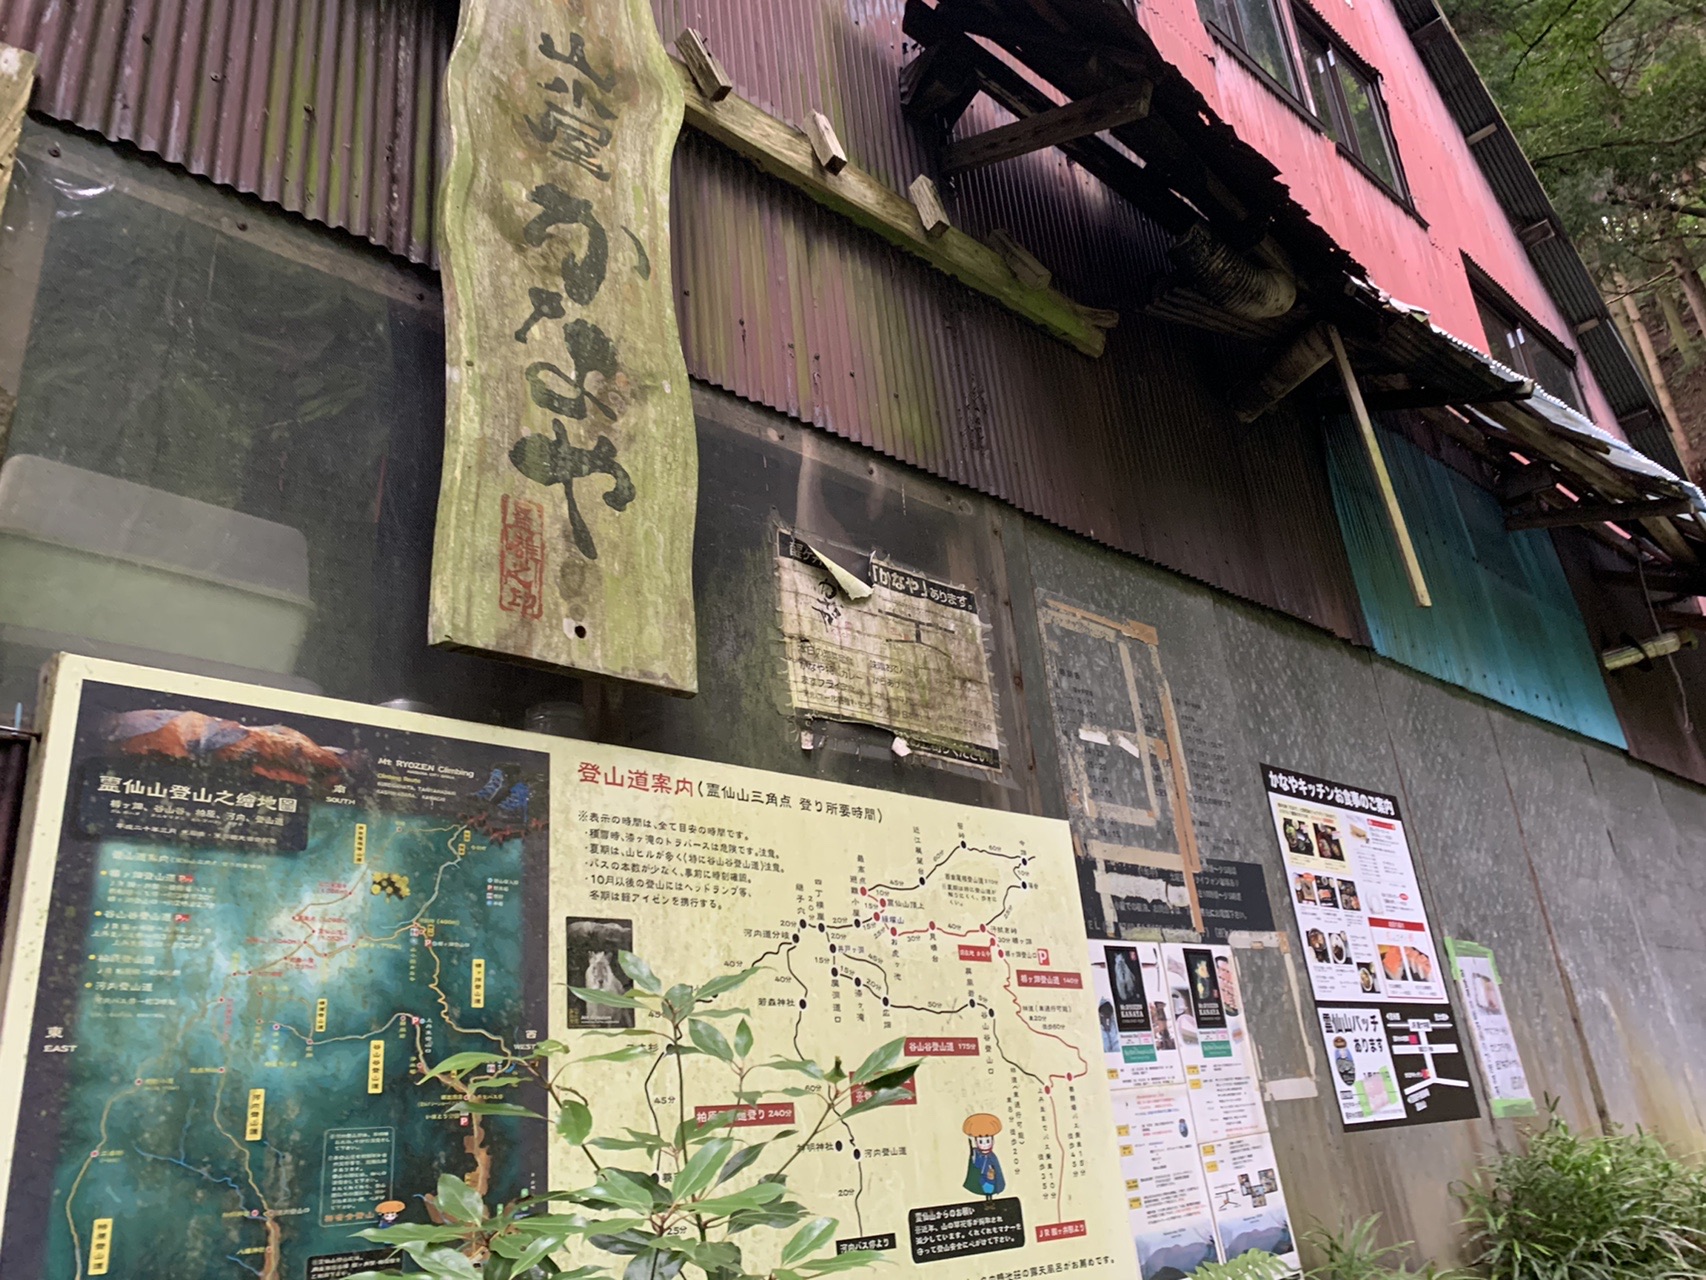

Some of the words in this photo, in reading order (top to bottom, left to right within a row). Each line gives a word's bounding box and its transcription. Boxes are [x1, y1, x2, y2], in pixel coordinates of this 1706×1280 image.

[395, 759, 435, 773] RYOZEN
[438, 764, 475, 779] Climbing
[577, 762, 694, 798] 登山道案内
[799, 797, 883, 824] 登り所要時間)
[1268, 770, 1395, 816] かなやキッチンお食事のご案内
[325, 796, 356, 805] SOUTH
[857, 855, 867, 884] 最高点
[780, 919, 797, 927] 20分
[832, 917, 848, 925] 20分
[743, 928, 790, 940] 河内道分岐
[831, 932, 847, 940] 20分
[814, 956, 830, 964] 15分
[45, 1026, 64, 1039] 東
[43, 1045, 77, 1053] EAST
[514, 1043, 537, 1051] WEST
[908, 1040, 955, 1053] 谷山谷登山道
[768, 1109, 792, 1119] 240分
